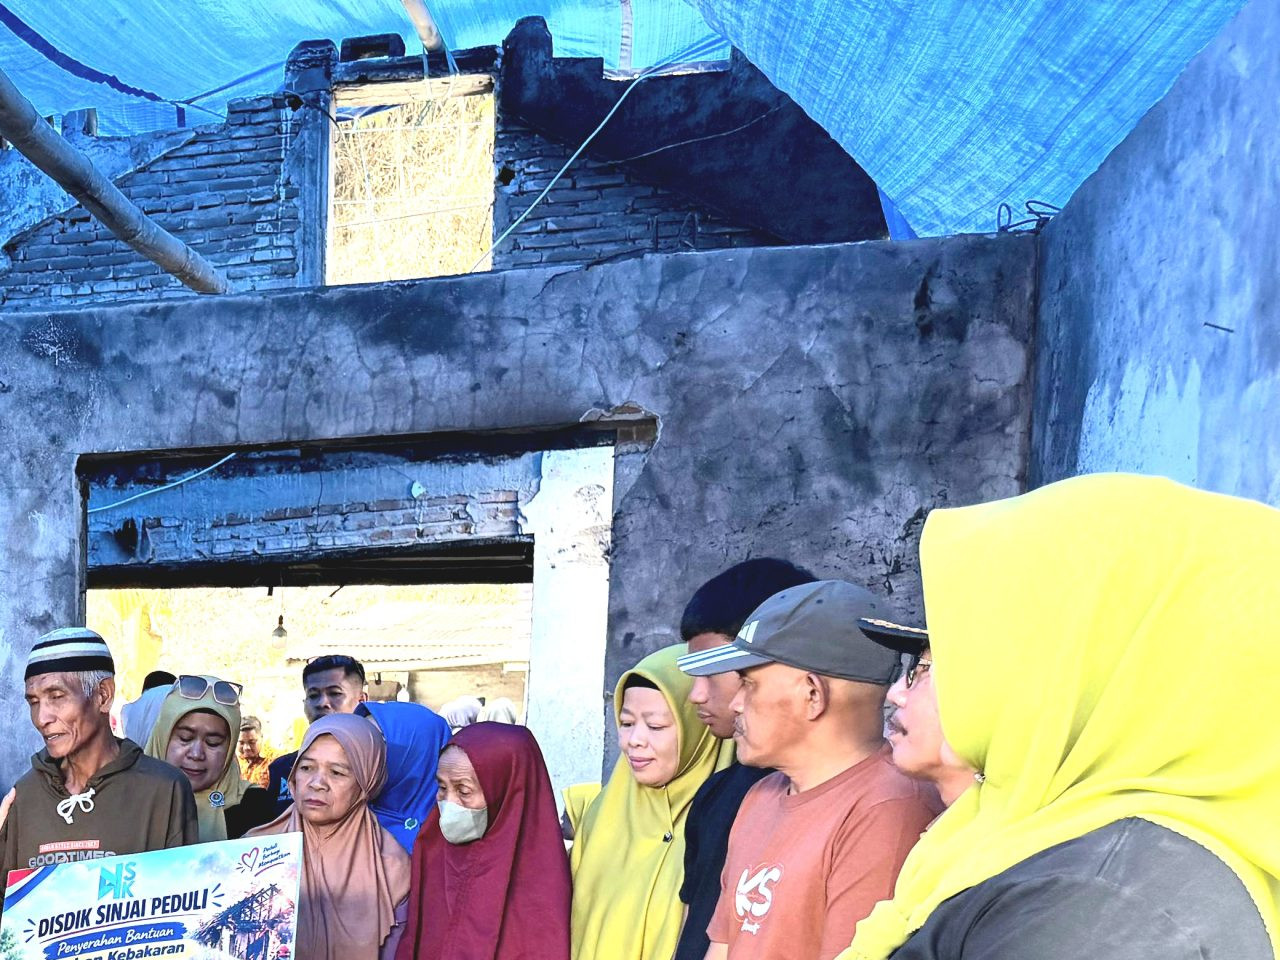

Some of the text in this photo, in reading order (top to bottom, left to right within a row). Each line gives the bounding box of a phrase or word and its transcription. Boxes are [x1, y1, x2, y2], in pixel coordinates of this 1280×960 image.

[38, 888, 209, 938] DISDIK SINJAI PEDULI
[735, 871, 781, 917] KS
[57, 927, 174, 956] Penyerahan Bantuan
